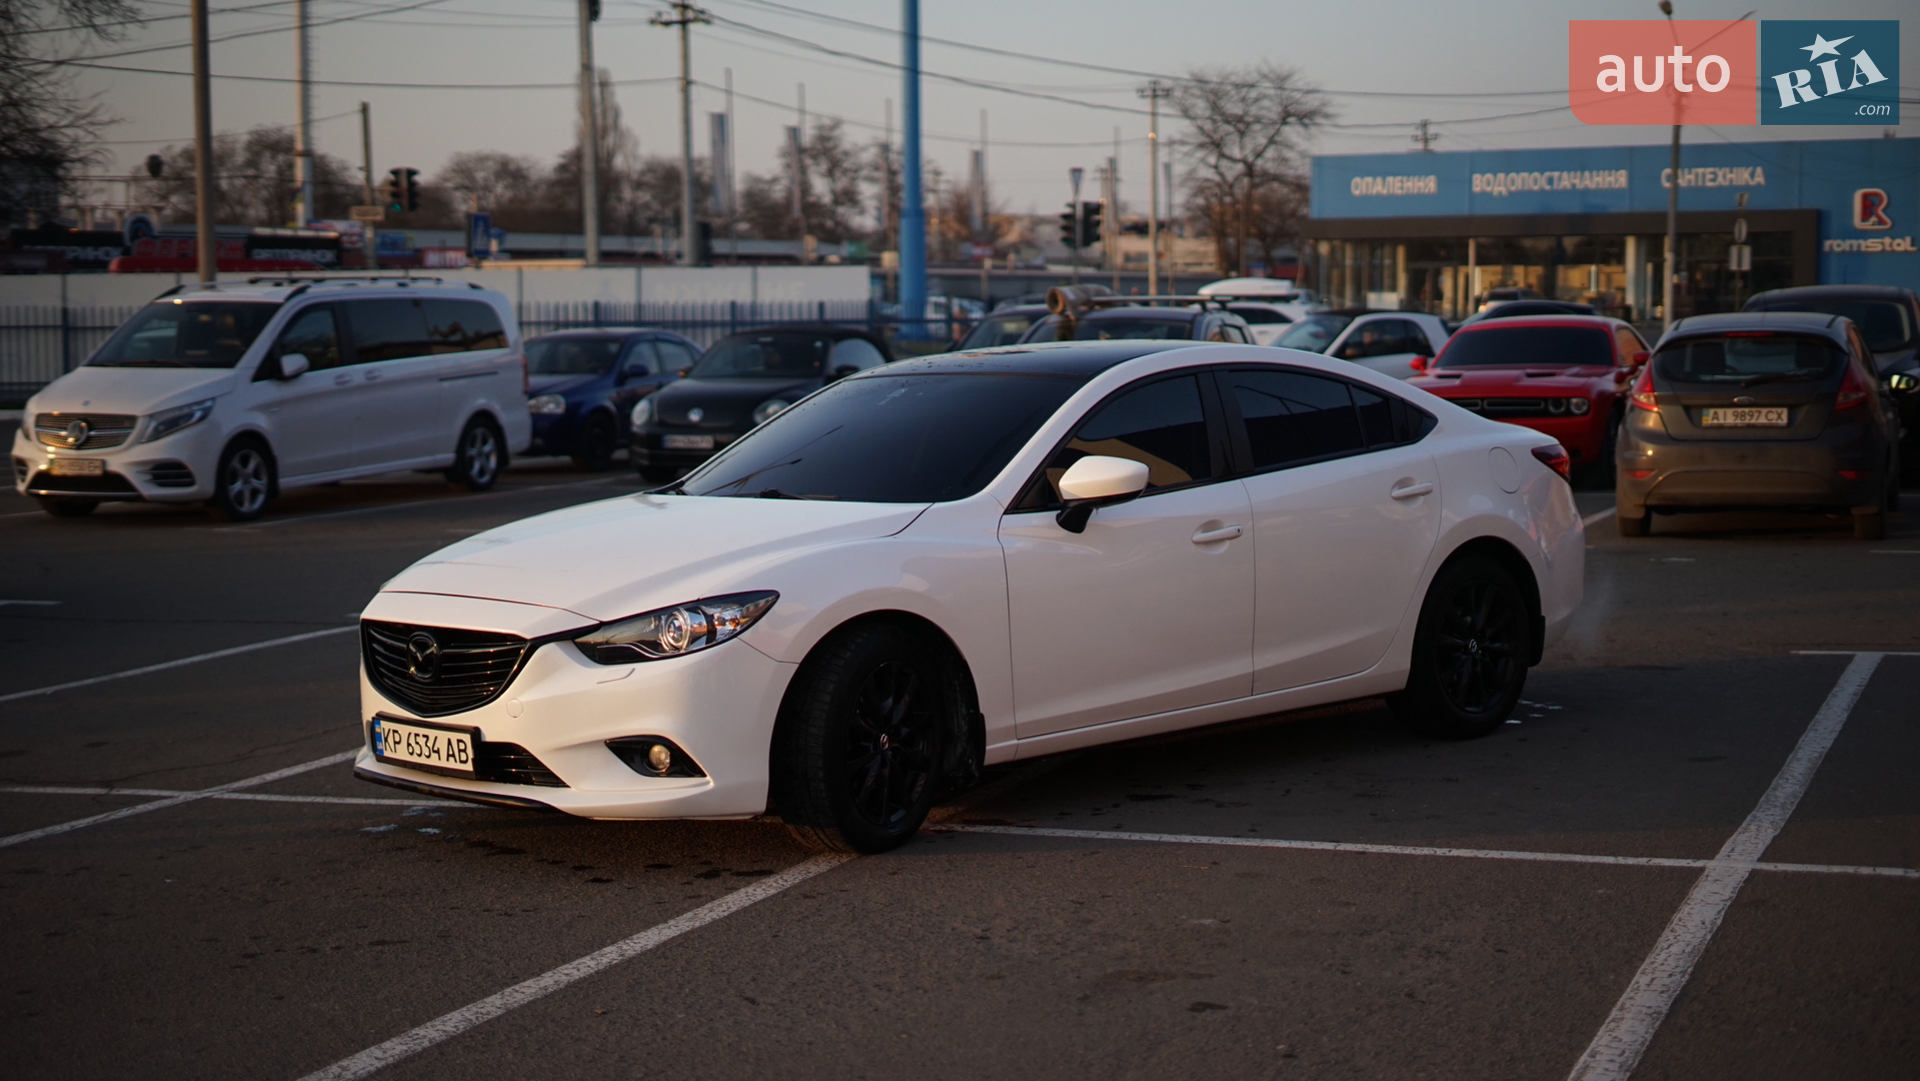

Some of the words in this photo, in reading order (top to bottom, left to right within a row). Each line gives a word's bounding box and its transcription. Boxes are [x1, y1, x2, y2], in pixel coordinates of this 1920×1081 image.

[1351, 175, 1437, 196] ОПАЛЕННЯ
[1472, 170, 1628, 195] ВОДОПОСТАЧАННЯ
[1661, 166, 1765, 187] САНТЕХНІКА
[1711, 410, 1727, 422] AI
[1732, 410, 1762, 422] 9897
[1765, 410, 1784, 422] CX
[382, 727, 402, 753] KP
[406, 732, 441, 761] 6534
[446, 738, 469, 764] AB
